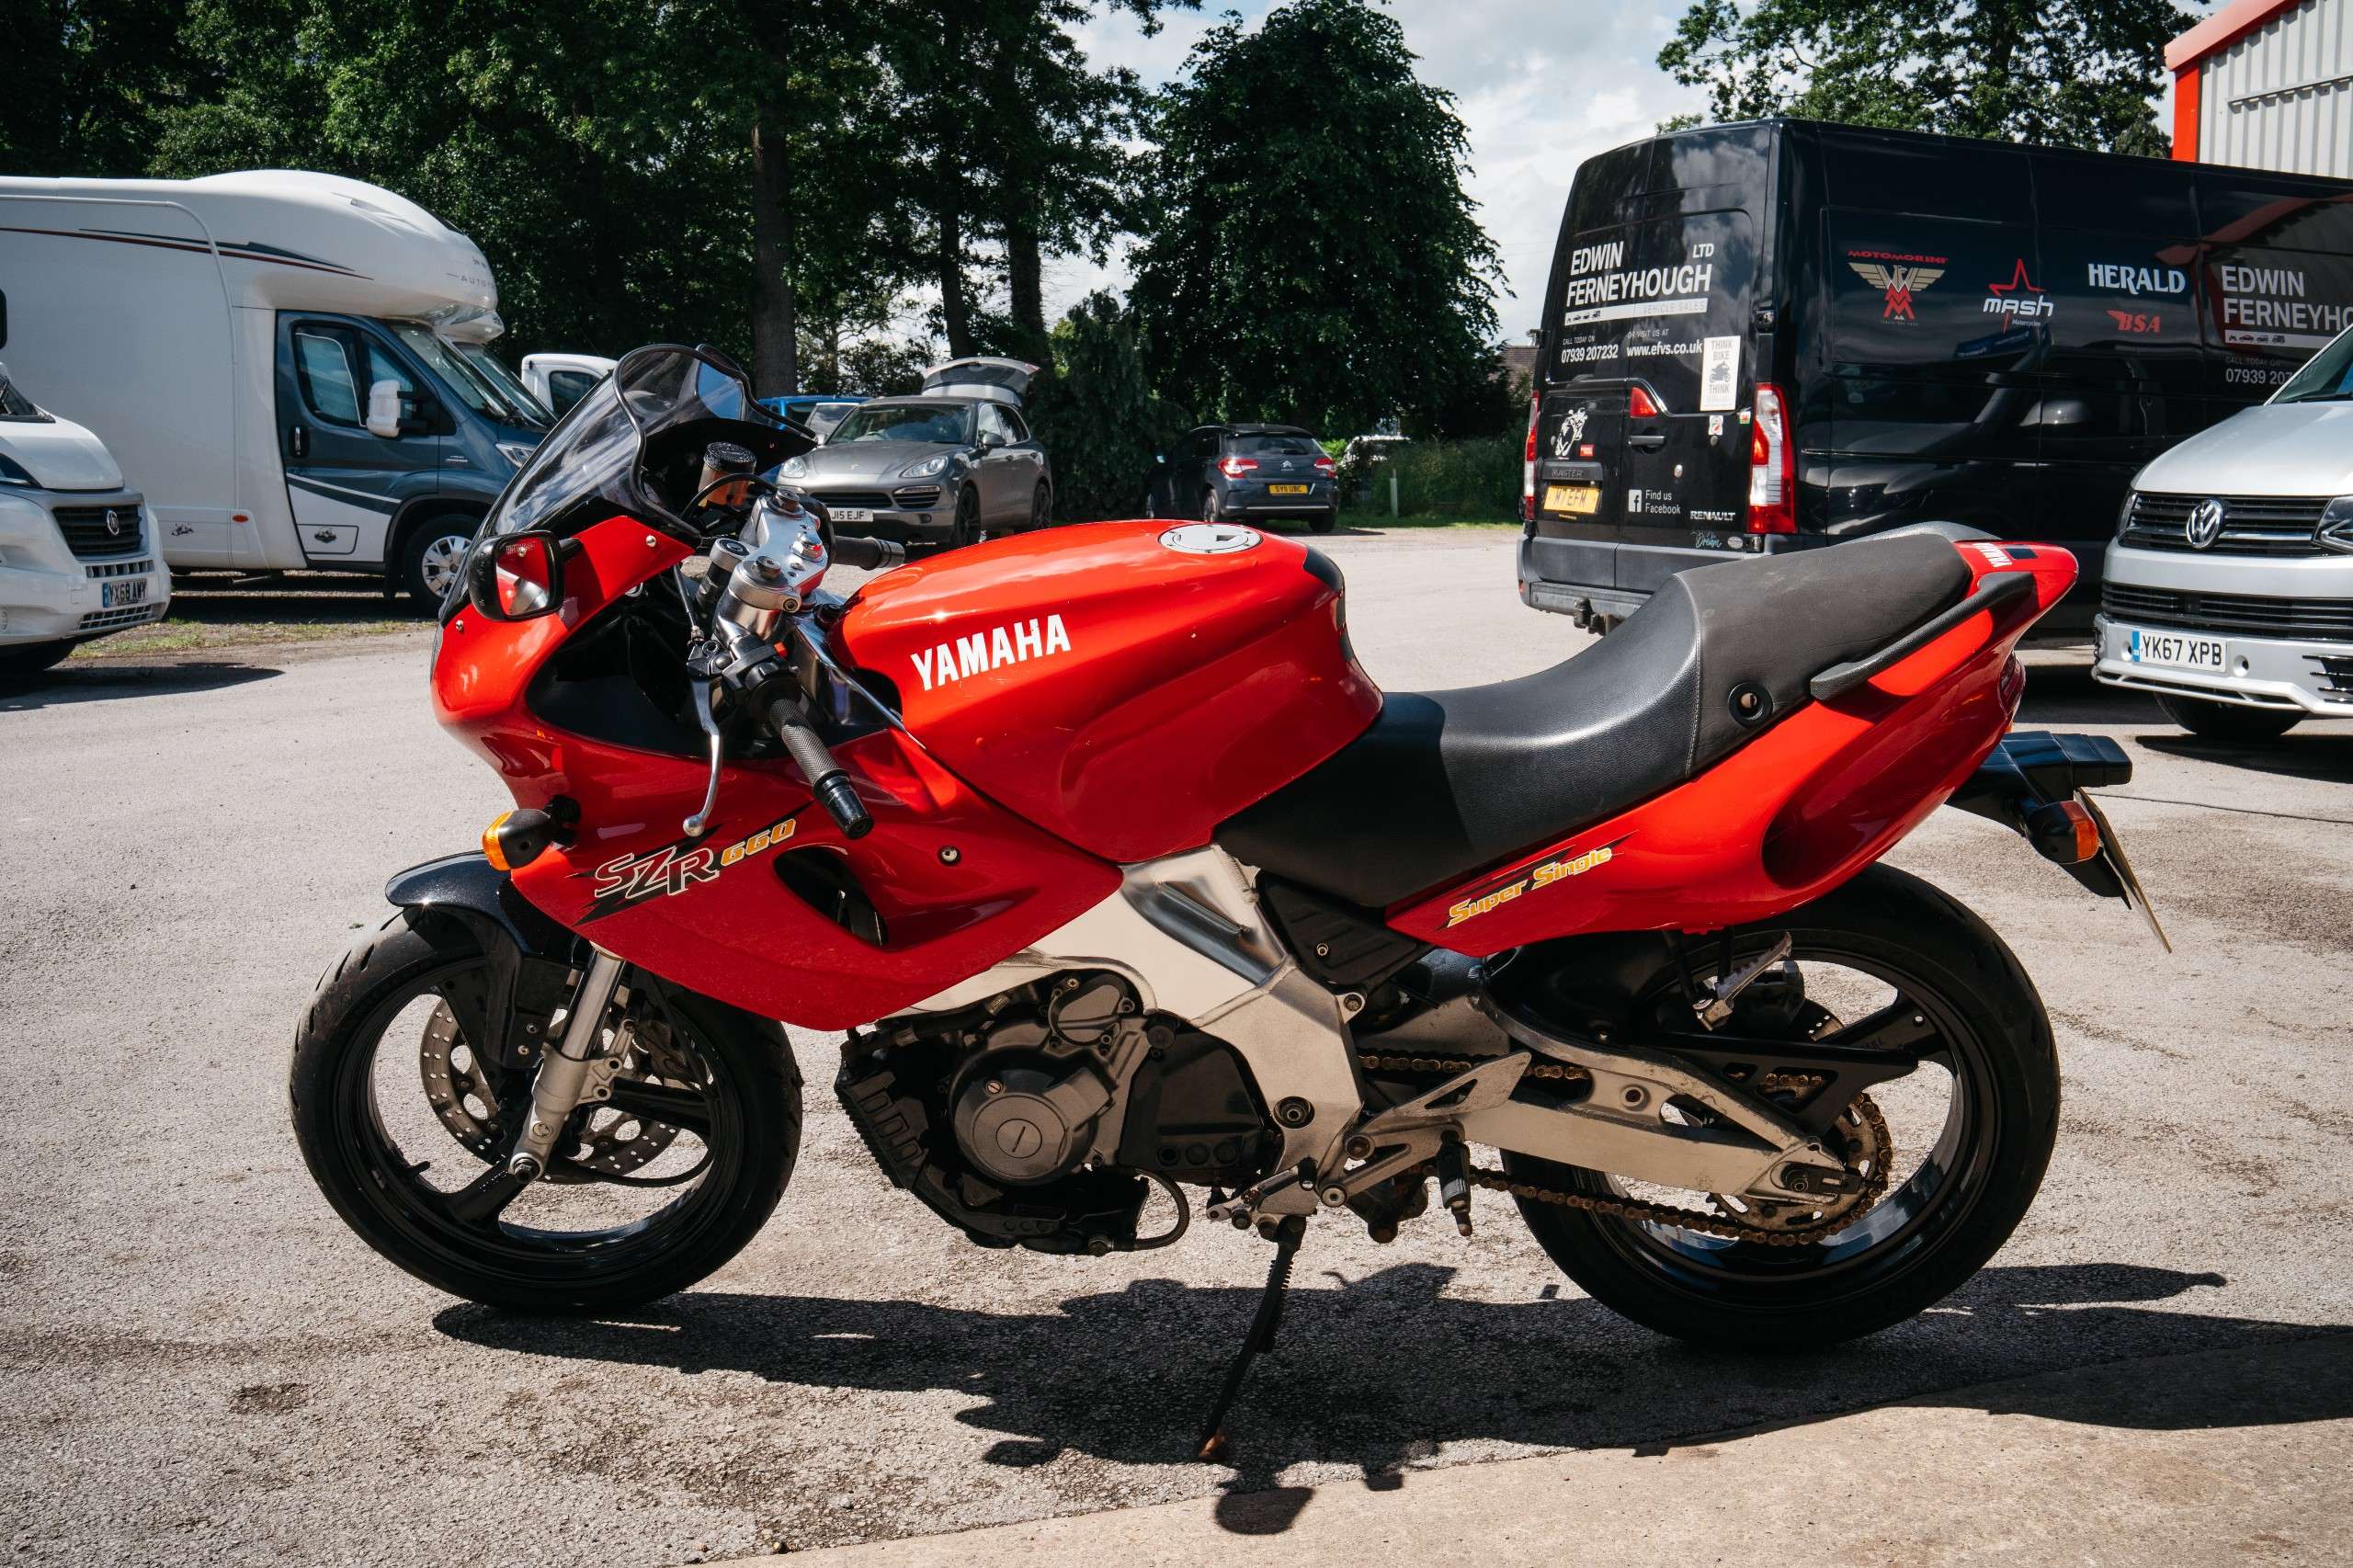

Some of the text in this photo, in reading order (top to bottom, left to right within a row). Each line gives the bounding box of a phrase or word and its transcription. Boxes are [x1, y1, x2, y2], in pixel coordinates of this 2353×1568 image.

[1570, 241, 1715, 276] EDWIN LTD
[1566, 263, 1713, 307] FERNEYHOUGH
[2087, 263, 2186, 294] HERALD
[2222, 266, 2305, 297] EDWIN
[2108, 310, 2161, 333] BSA
[1652, 329, 1660, 337] US
[1662, 328, 1670, 336] AT
[1562, 345, 1619, 363] 07939 207232
[1627, 339, 1703, 358] www.efvs.co.uk
[1711, 340, 1733, 350] THINK
[1712, 350, 1730, 360] BIKE
[2225, 368, 2267, 384] 07939
[1709, 383, 1730, 394] THINK
[1645, 490, 1672, 501] Find us
[847, 511, 865, 520] EJF
[1645, 503, 1681, 515] Facebook
[1690, 510, 1735, 521] RENAULT
[910, 614, 1072, 691] YAMAHA
[2143, 635, 2222, 666] YK67 XPB
[595, 818, 797, 899] SZR 660
[1447, 846, 1613, 928] Super Single
